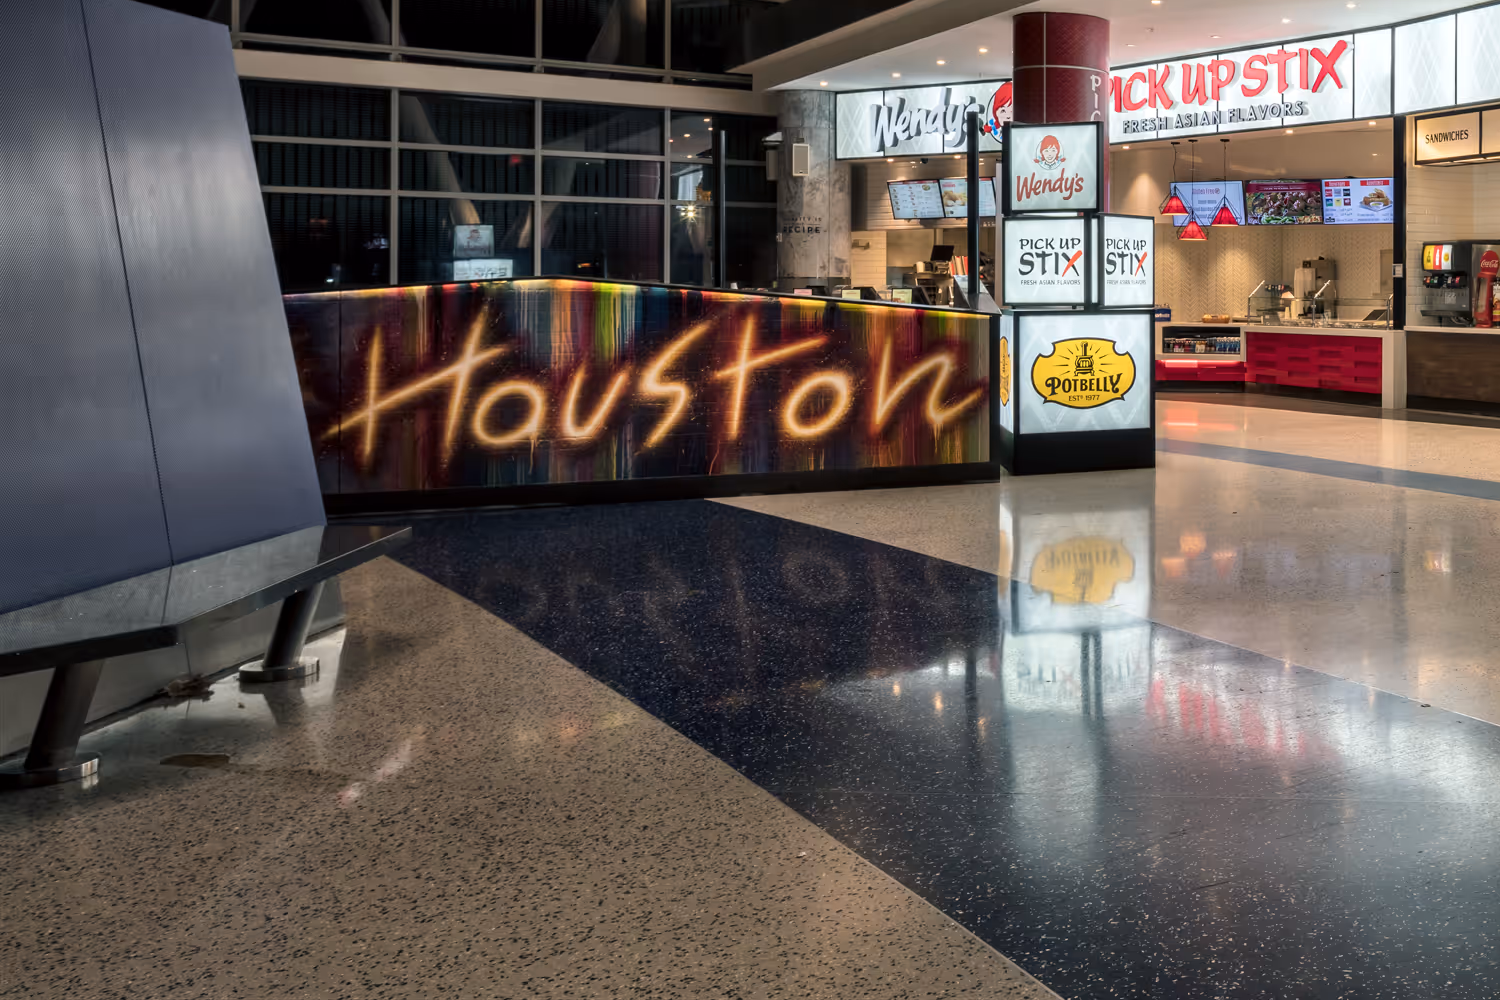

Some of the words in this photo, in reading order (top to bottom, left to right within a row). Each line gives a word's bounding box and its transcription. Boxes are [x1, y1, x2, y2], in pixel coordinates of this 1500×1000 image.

[1181, 59, 1236, 106] UP
[1241, 39, 1349, 98] STIX
[1123, 117, 1169, 134] FRESH
[1174, 111, 1222, 129] ASIAN
[1228, 101, 1306, 124] FLAVORS
[1425, 129, 1469, 144] SANDWICHES
[1016, 168, 1084, 202] Wendy's
[1019, 238, 1055, 250] PICK
[1059, 237, 1081, 250] UP
[1105, 238, 1130, 250] PICK
[1132, 240, 1147, 251] UP
[1018, 250, 1083, 278] STIX
[1105, 251, 1148, 277] STIX
[321, 305, 985, 472] Houston
[1045, 373, 1123, 397] POTBELLY
